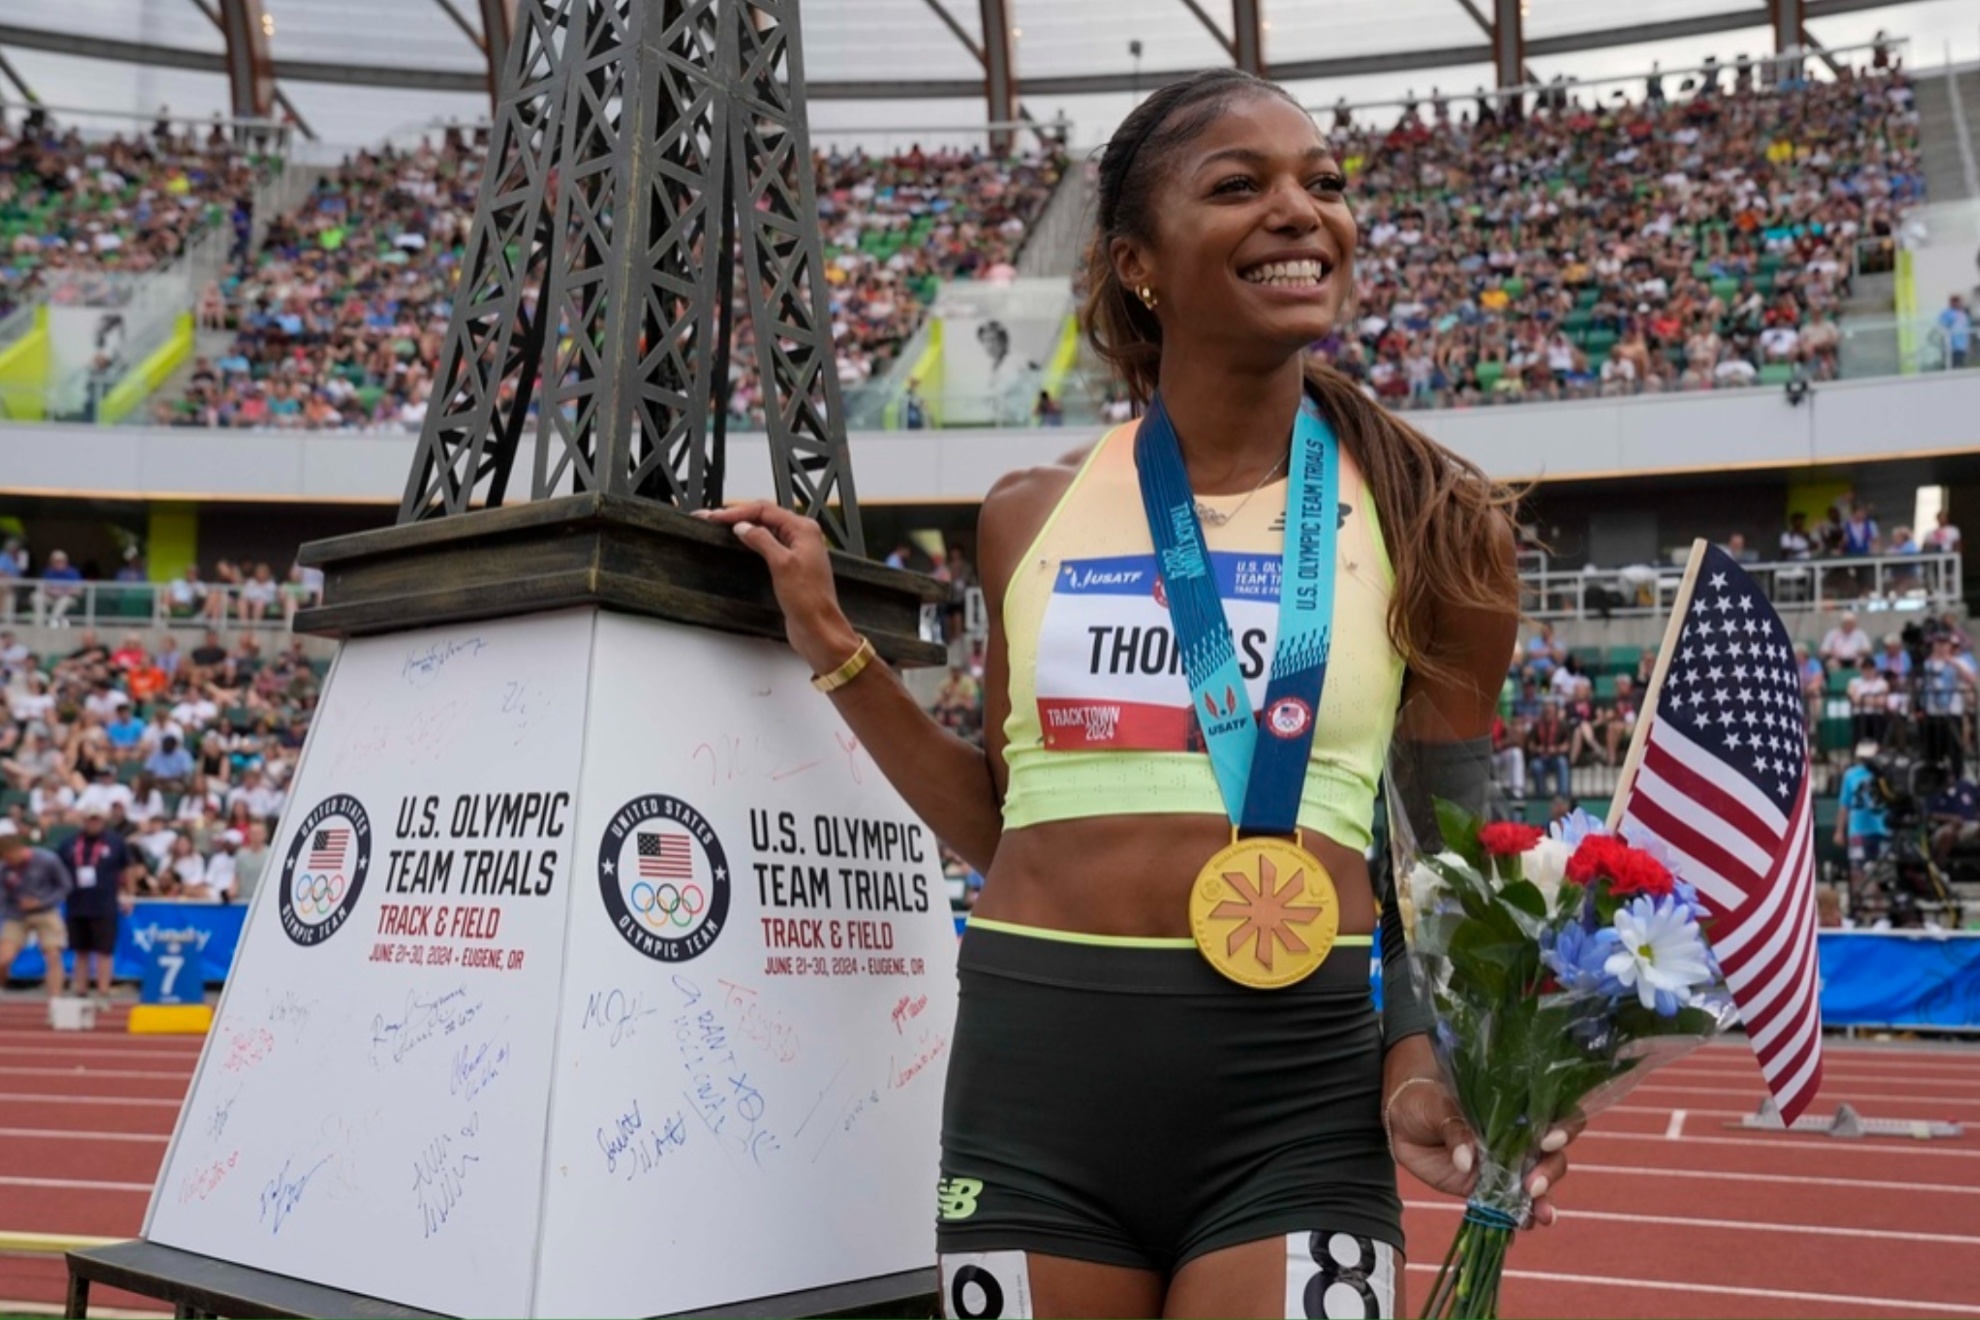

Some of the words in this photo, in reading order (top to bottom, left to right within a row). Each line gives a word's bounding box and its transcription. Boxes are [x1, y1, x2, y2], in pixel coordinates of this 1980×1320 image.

[1304, 438, 1324, 482] TRIALS
[1302, 484, 1323, 521] TEAM
[1236, 560, 1259, 573] U.S.
[1298, 522, 1322, 581] OLYMPIC
[1091, 571, 1143, 585] USATF
[1235, 573, 1268, 585] TEAM
[1296, 583, 1318, 611] U.S.
[1088, 625, 1268, 680] THOS
[1047, 705, 1121, 728] TRACKTOWN
[1086, 722, 1115, 741] 2024
[1208, 717, 1248, 736] USATF
[301, 798, 338, 838] UNITED
[337, 797, 368, 837] STATES
[395, 796, 440, 839] U.S.
[450, 790, 570, 838] OLYMPIC
[610, 798, 659, 839] UNITED
[664, 800, 713, 845] STATES
[750, 807, 805, 855] U.S.
[814, 815, 924, 863] OLYMPIC
[385, 850, 454, 894] TEAM
[460, 850, 557, 896] TRIALS
[753, 863, 831, 908] TEAM
[839, 869, 929, 913] TRIALS
[282, 903, 314, 943] OLYMPIC
[319, 907, 349, 939] TEAM
[377, 904, 433, 936] TRACK
[434, 906, 448, 937] &
[450, 906, 501, 939] FIELD
[618, 916, 680, 958] OLYMPIC
[686, 918, 719, 955] TEAM
[761, 918, 823, 948] TRACK
[830, 919, 843, 948] &
[848, 921, 894, 950] FIELD
[159, 955, 185, 995] 7
[369, 944, 394, 963] JUNE
[427, 946, 452, 967] 2024
[461, 948, 504, 970] EUGENE,
[507, 951, 524, 970] OR
[764, 957, 793, 975] JUNE
[833, 958, 858, 976] 2024
[868, 957, 909, 977] EUGENE,
[911, 958, 925, 976] OR
[1303, 1230, 1380, 1320] 8
